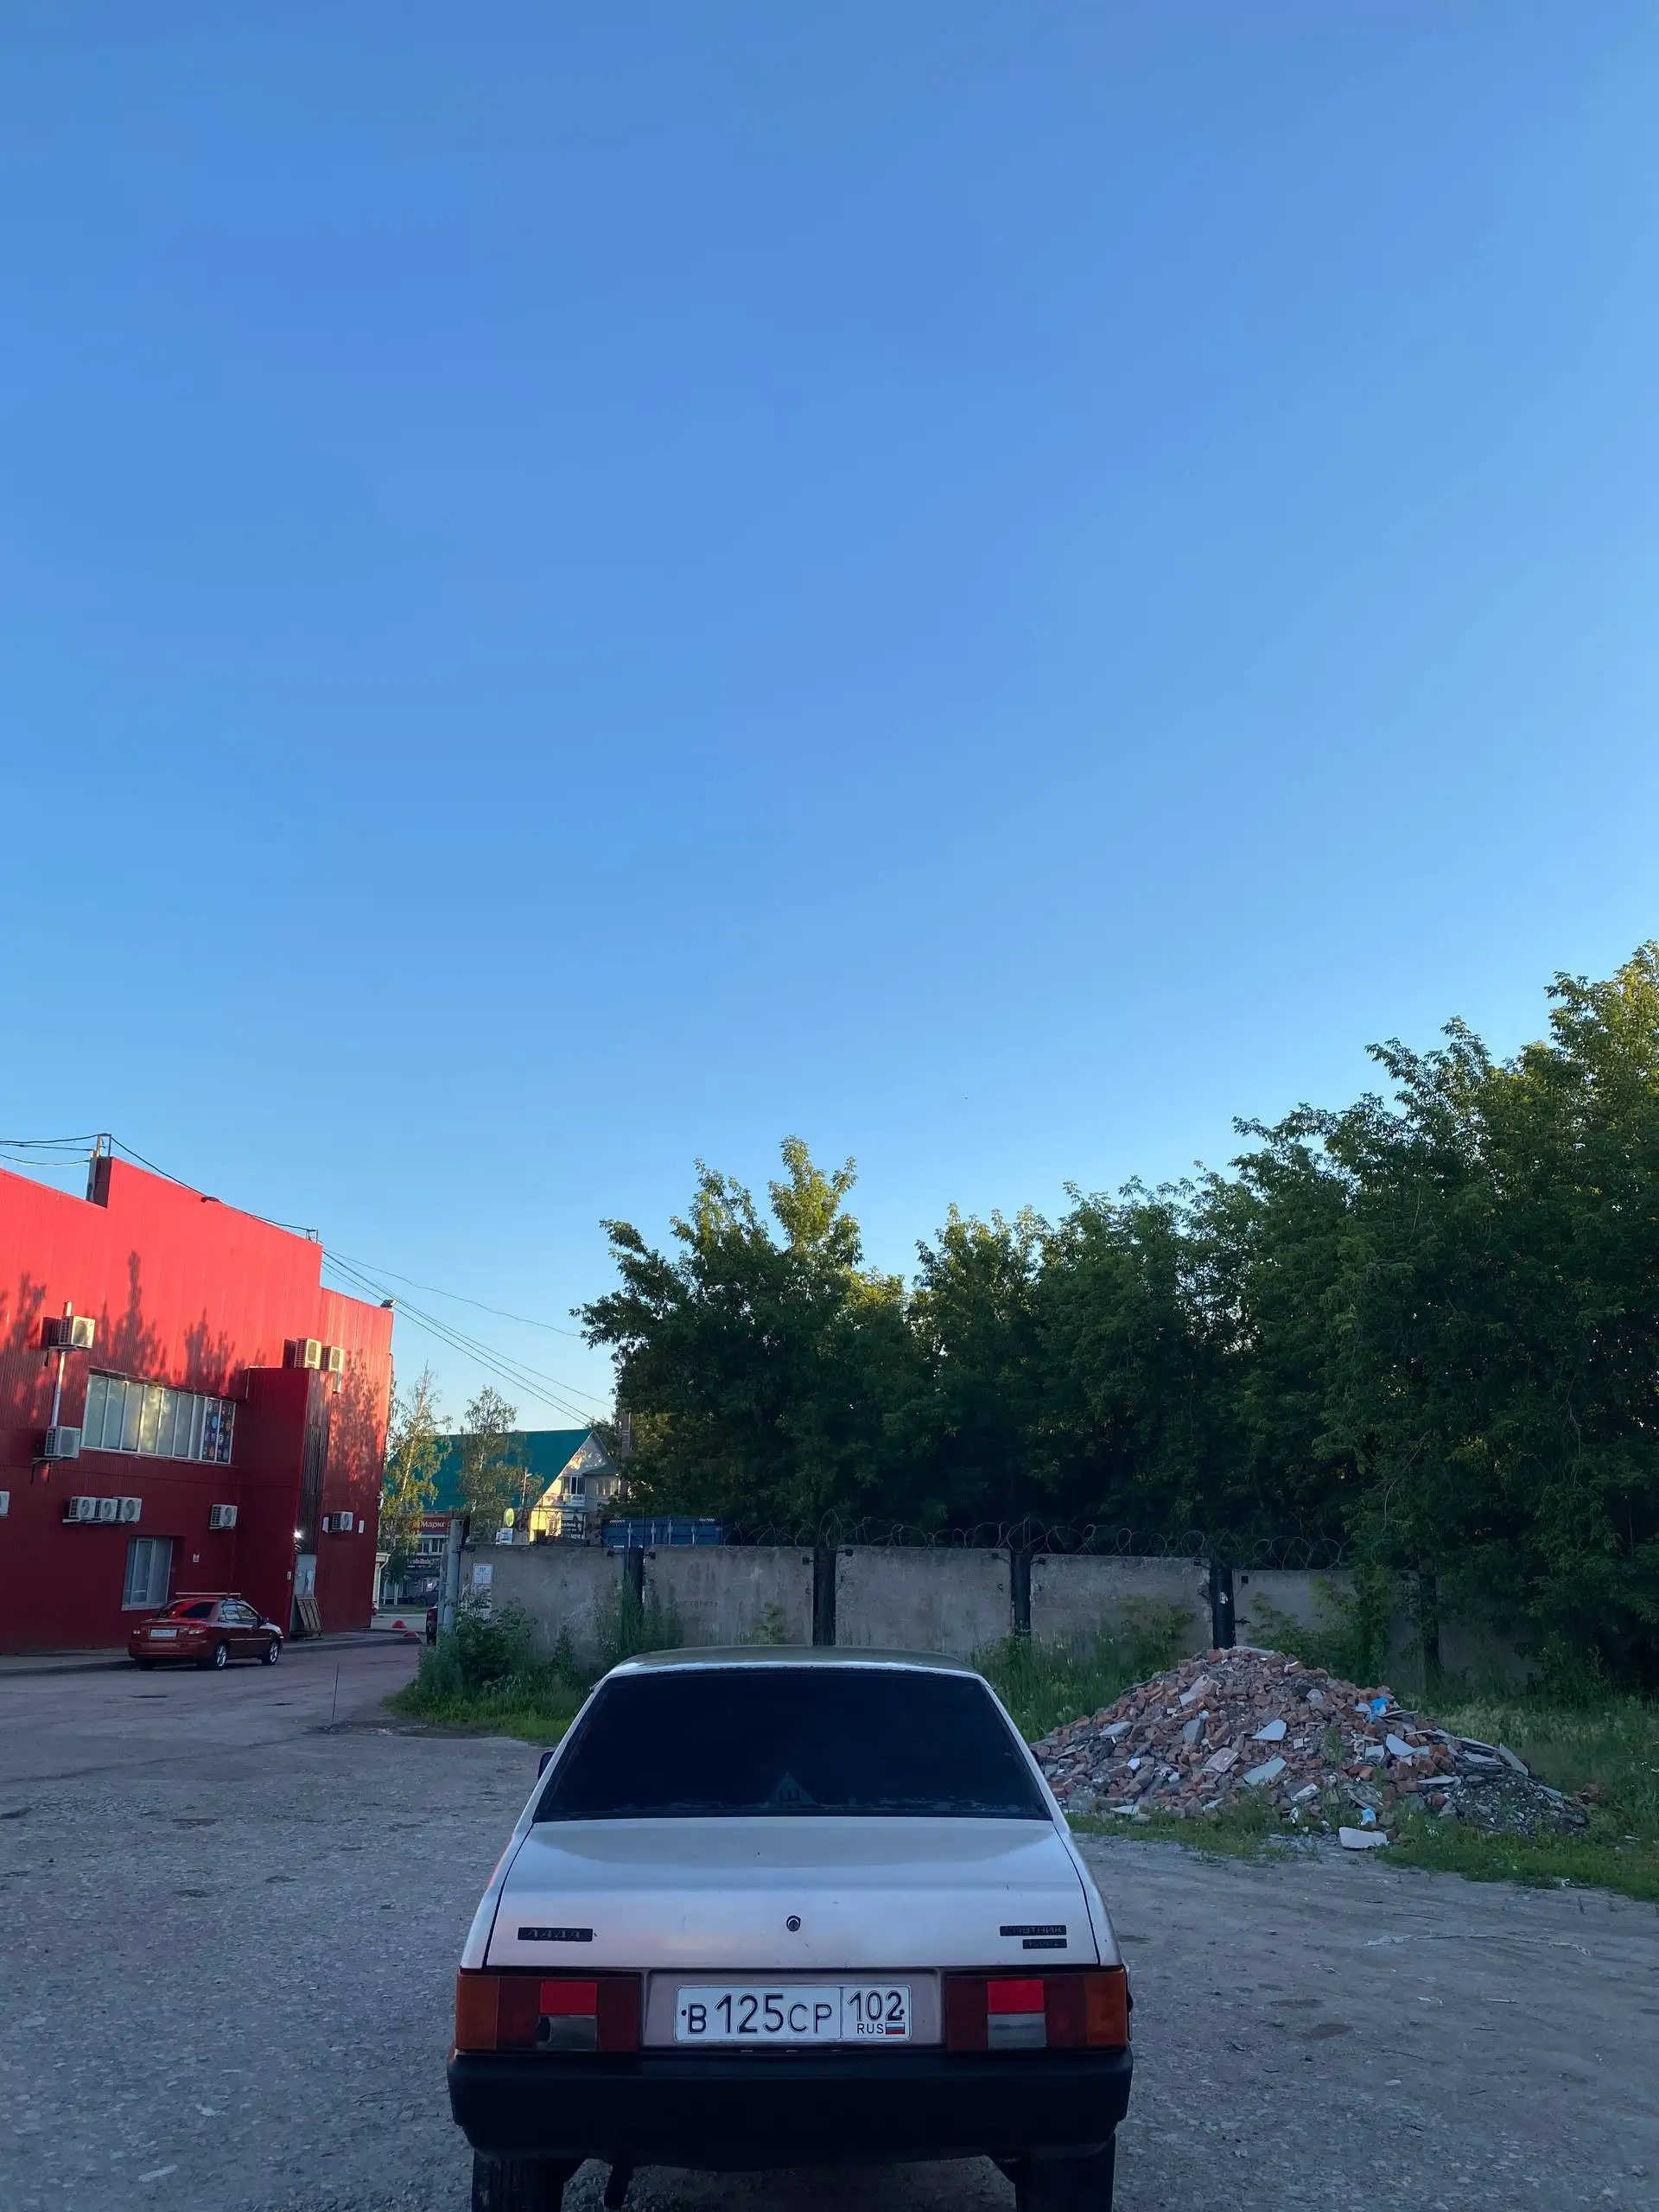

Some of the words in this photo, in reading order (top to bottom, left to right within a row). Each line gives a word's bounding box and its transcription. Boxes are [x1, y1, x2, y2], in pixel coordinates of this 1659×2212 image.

[689, 1993, 832, 2033] В125СР
[848, 1990, 903, 2021] 102
[856, 2023, 884, 2034] RUS
